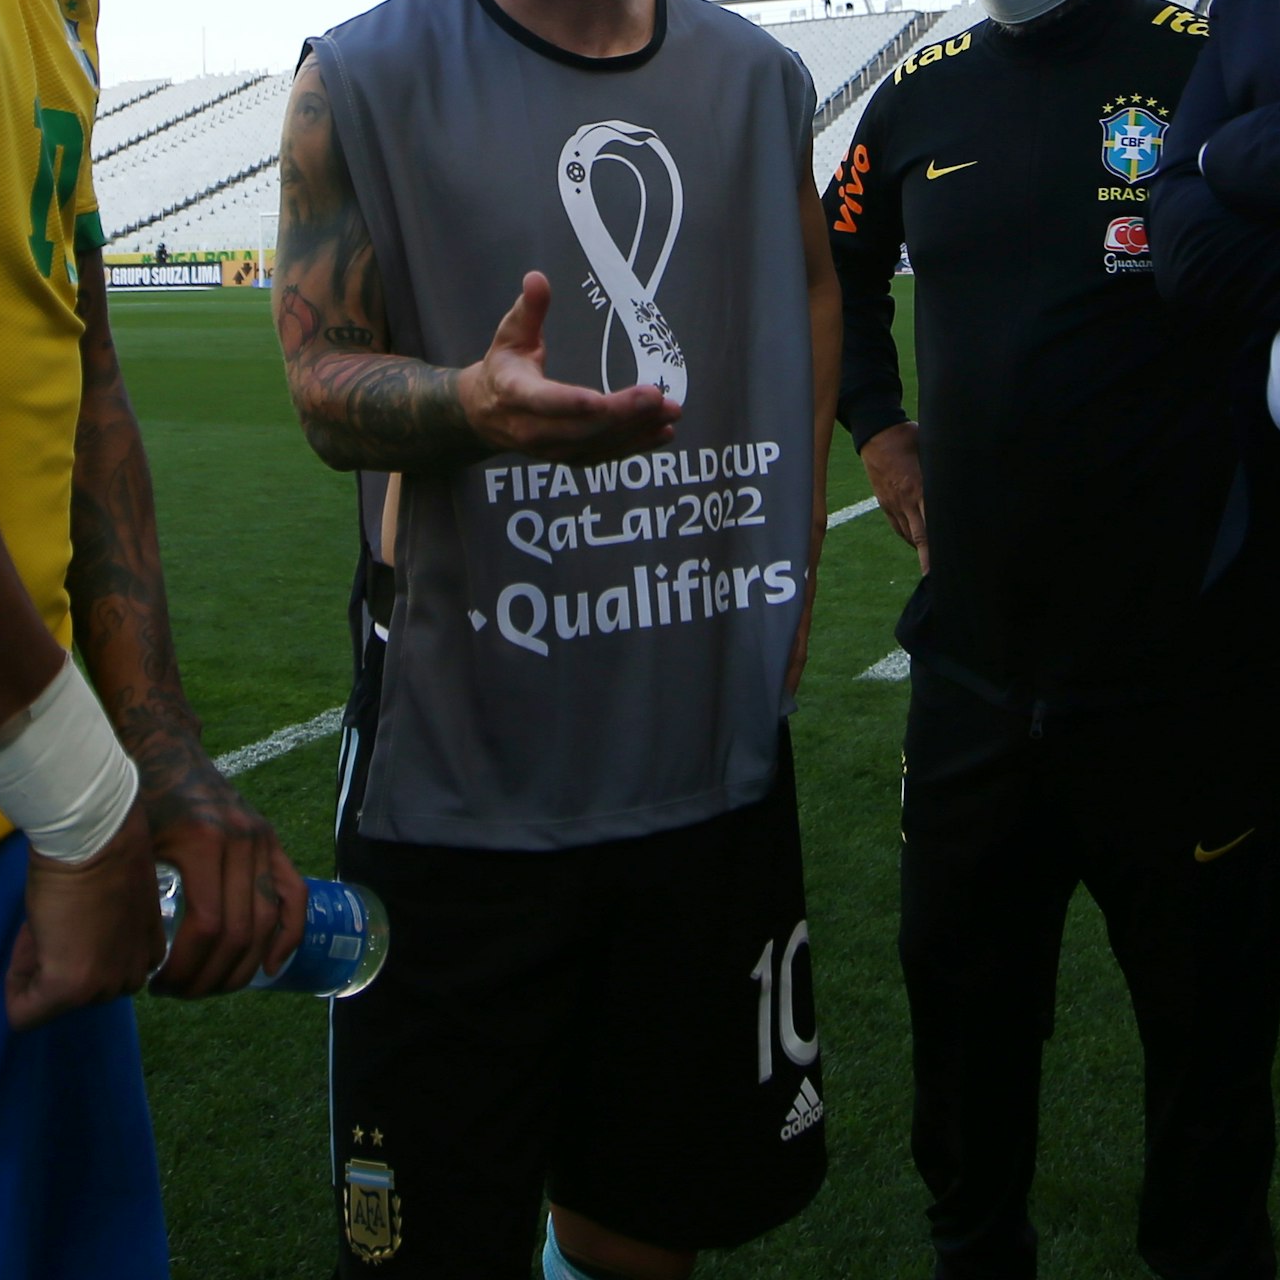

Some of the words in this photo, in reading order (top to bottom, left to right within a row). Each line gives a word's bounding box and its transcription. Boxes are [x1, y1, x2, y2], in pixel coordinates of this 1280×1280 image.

[1151, 5, 1210, 37] Ita
[893, 30, 972, 85] Itaú
[1121, 137, 1146, 148] CBF
[833, 144, 870, 234] vivo
[1097, 187, 1150, 201] BRAS
[112, 267, 150, 286] GRUPO
[151, 266, 190, 285] SOUZA
[190, 264, 220, 284] LIMA
[1103, 252, 1153, 274] Guaran
[581, 271, 607, 310] TM
[485, 463, 580, 503] FIFA
[584, 447, 718, 494] WORLD
[721, 441, 780, 479] CUP
[496, 557, 797, 657] Qualifiers
[750, 919, 819, 1085] 10
